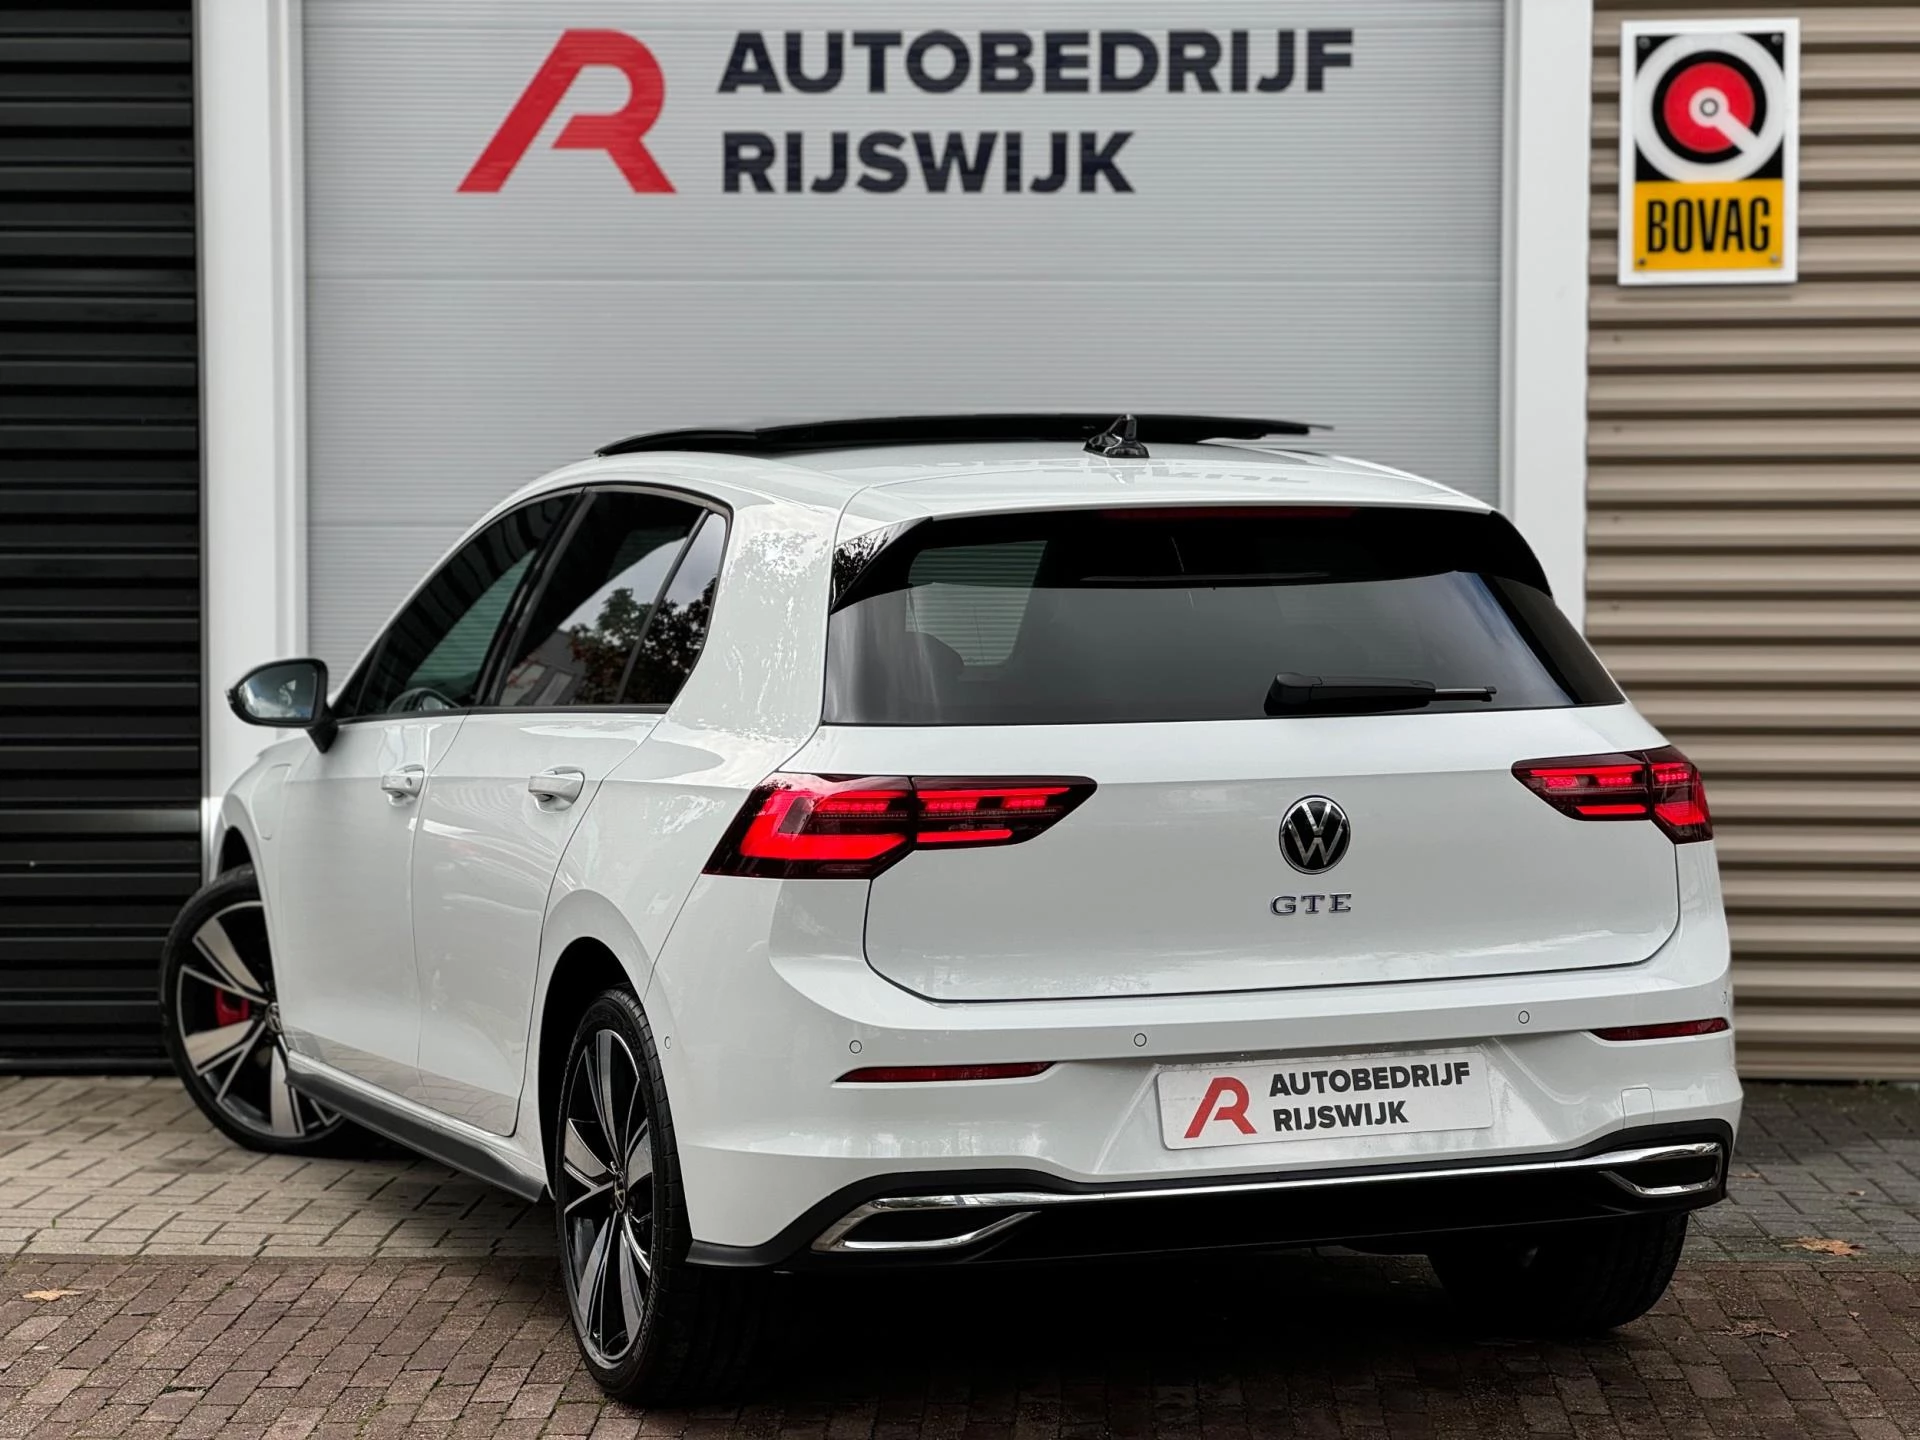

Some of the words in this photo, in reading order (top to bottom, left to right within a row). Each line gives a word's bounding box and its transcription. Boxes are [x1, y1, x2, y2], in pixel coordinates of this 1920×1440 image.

[718, 28, 1353, 94] AUTOBEDRIJF
[723, 131, 1135, 194] RIJSWIJK
[1647, 198, 1770, 253] BOVAG
[1270, 893, 1352, 916] GTE
[1269, 1062, 1470, 1097] AUTOBEDRIJF
[1273, 1100, 1409, 1132] RIJSWIJK
